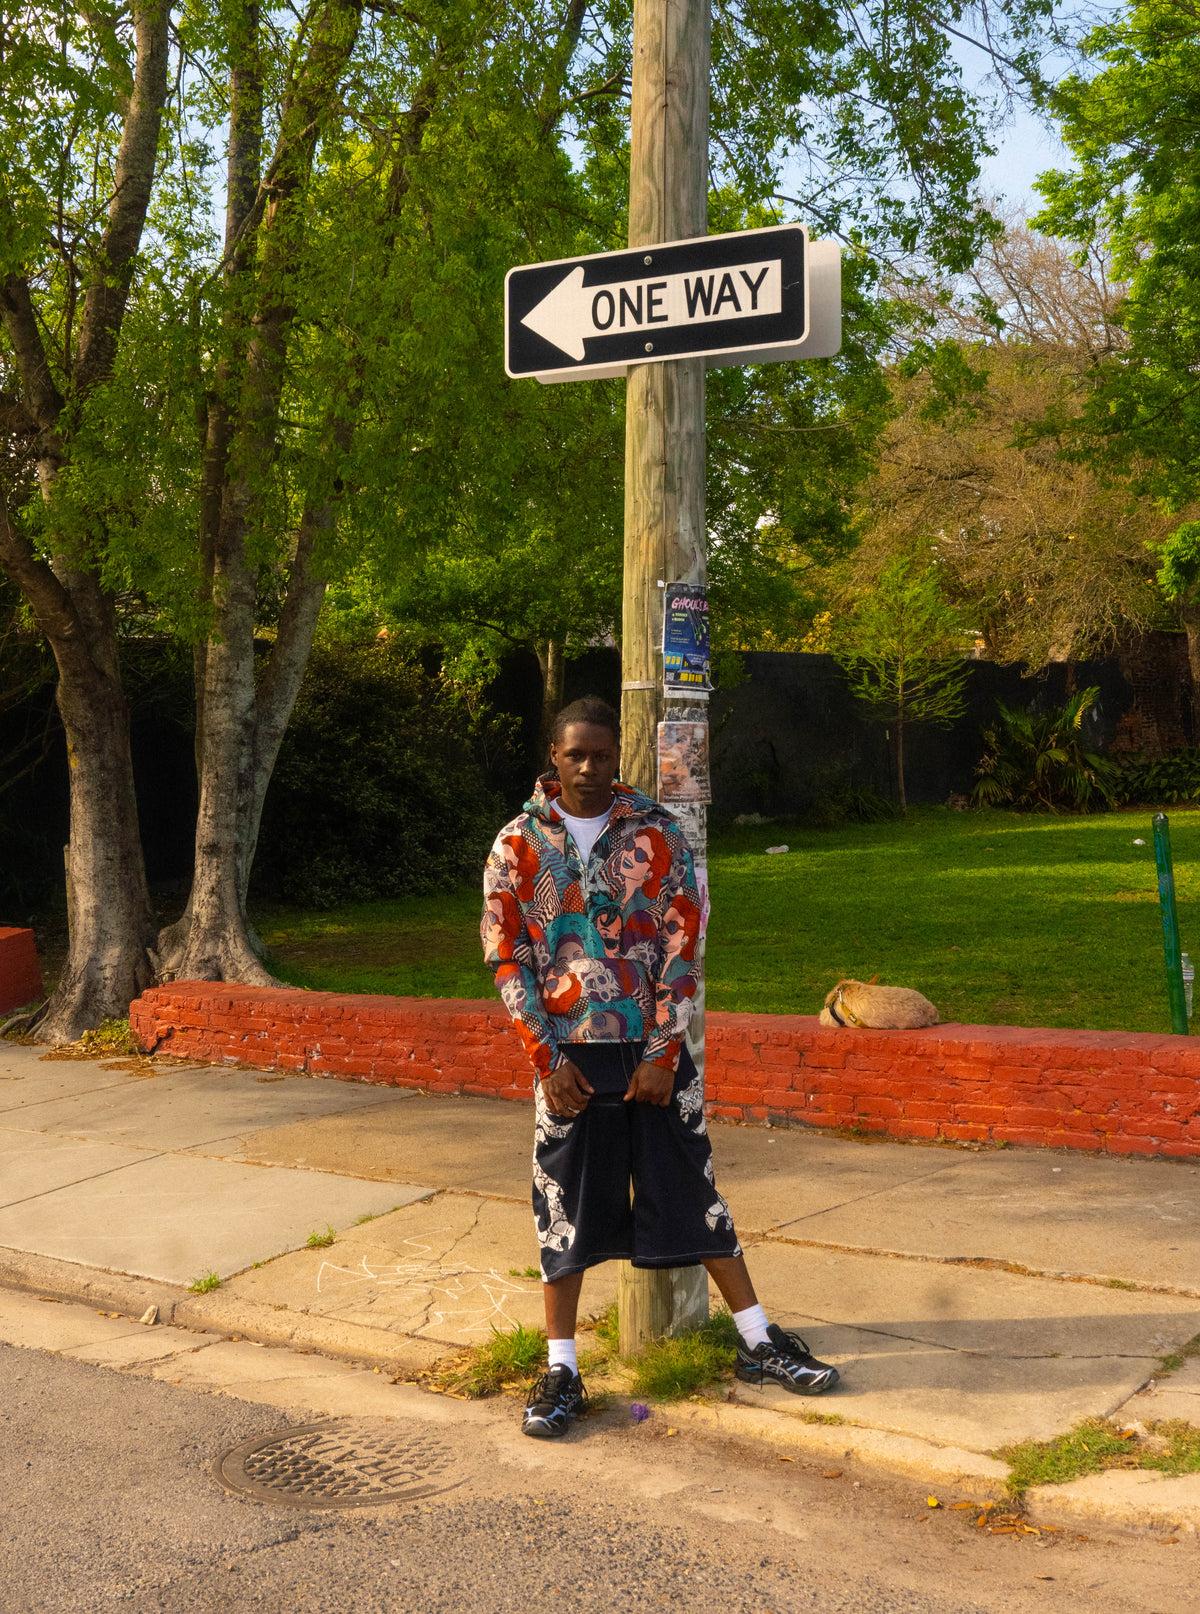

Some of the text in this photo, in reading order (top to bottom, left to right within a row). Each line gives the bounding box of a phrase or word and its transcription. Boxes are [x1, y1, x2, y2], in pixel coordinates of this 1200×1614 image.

[591, 267, 770, 331] ONE WAY
[289, 1433, 425, 1488] DRAIN
